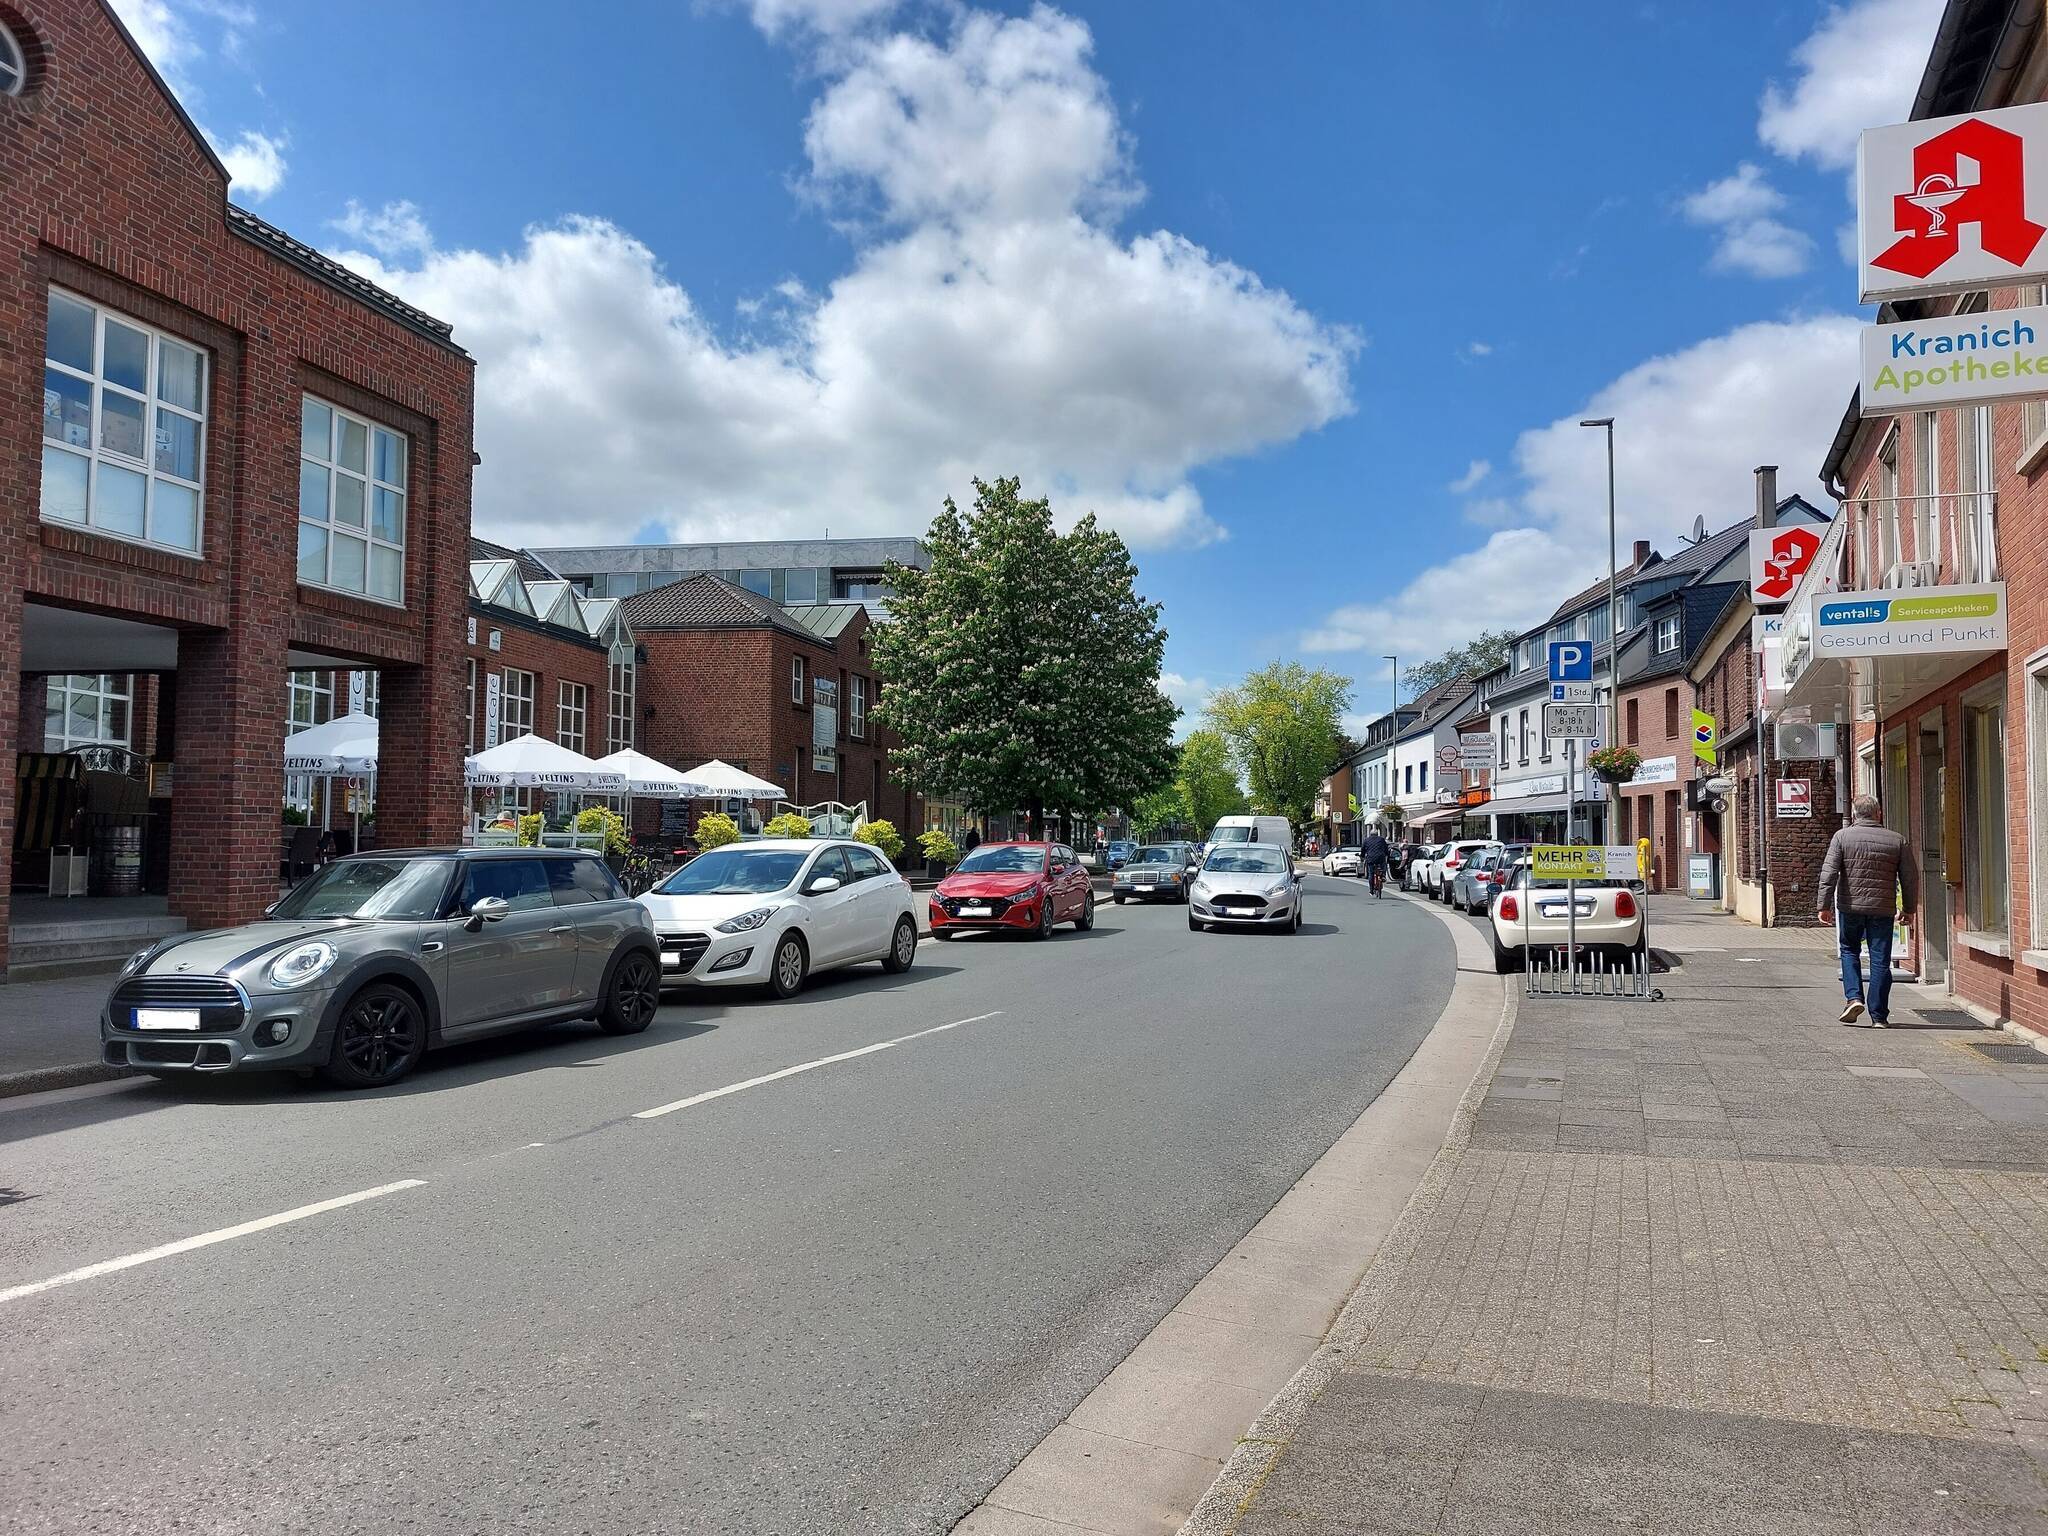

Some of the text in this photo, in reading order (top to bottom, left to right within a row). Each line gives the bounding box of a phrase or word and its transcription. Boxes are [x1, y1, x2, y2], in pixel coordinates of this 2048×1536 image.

[1891, 319, 2034, 358] Kranich
[1873, 351, 2048, 394] Apotheke
[1897, 603, 1989, 617] Serviceapotheken
[1820, 625, 2000, 648] Gesund und Punkt.
[1555, 708, 1568, 716] Mo
[1577, 708, 1587, 716] Fr
[1559, 716, 1583, 725] 8-18 h
[1566, 725, 1584, 734] 8-14
[538, 774, 575, 783] VELTINS
[649, 783, 679, 791] VELTINS
[1537, 851, 1583, 862] MEHR
